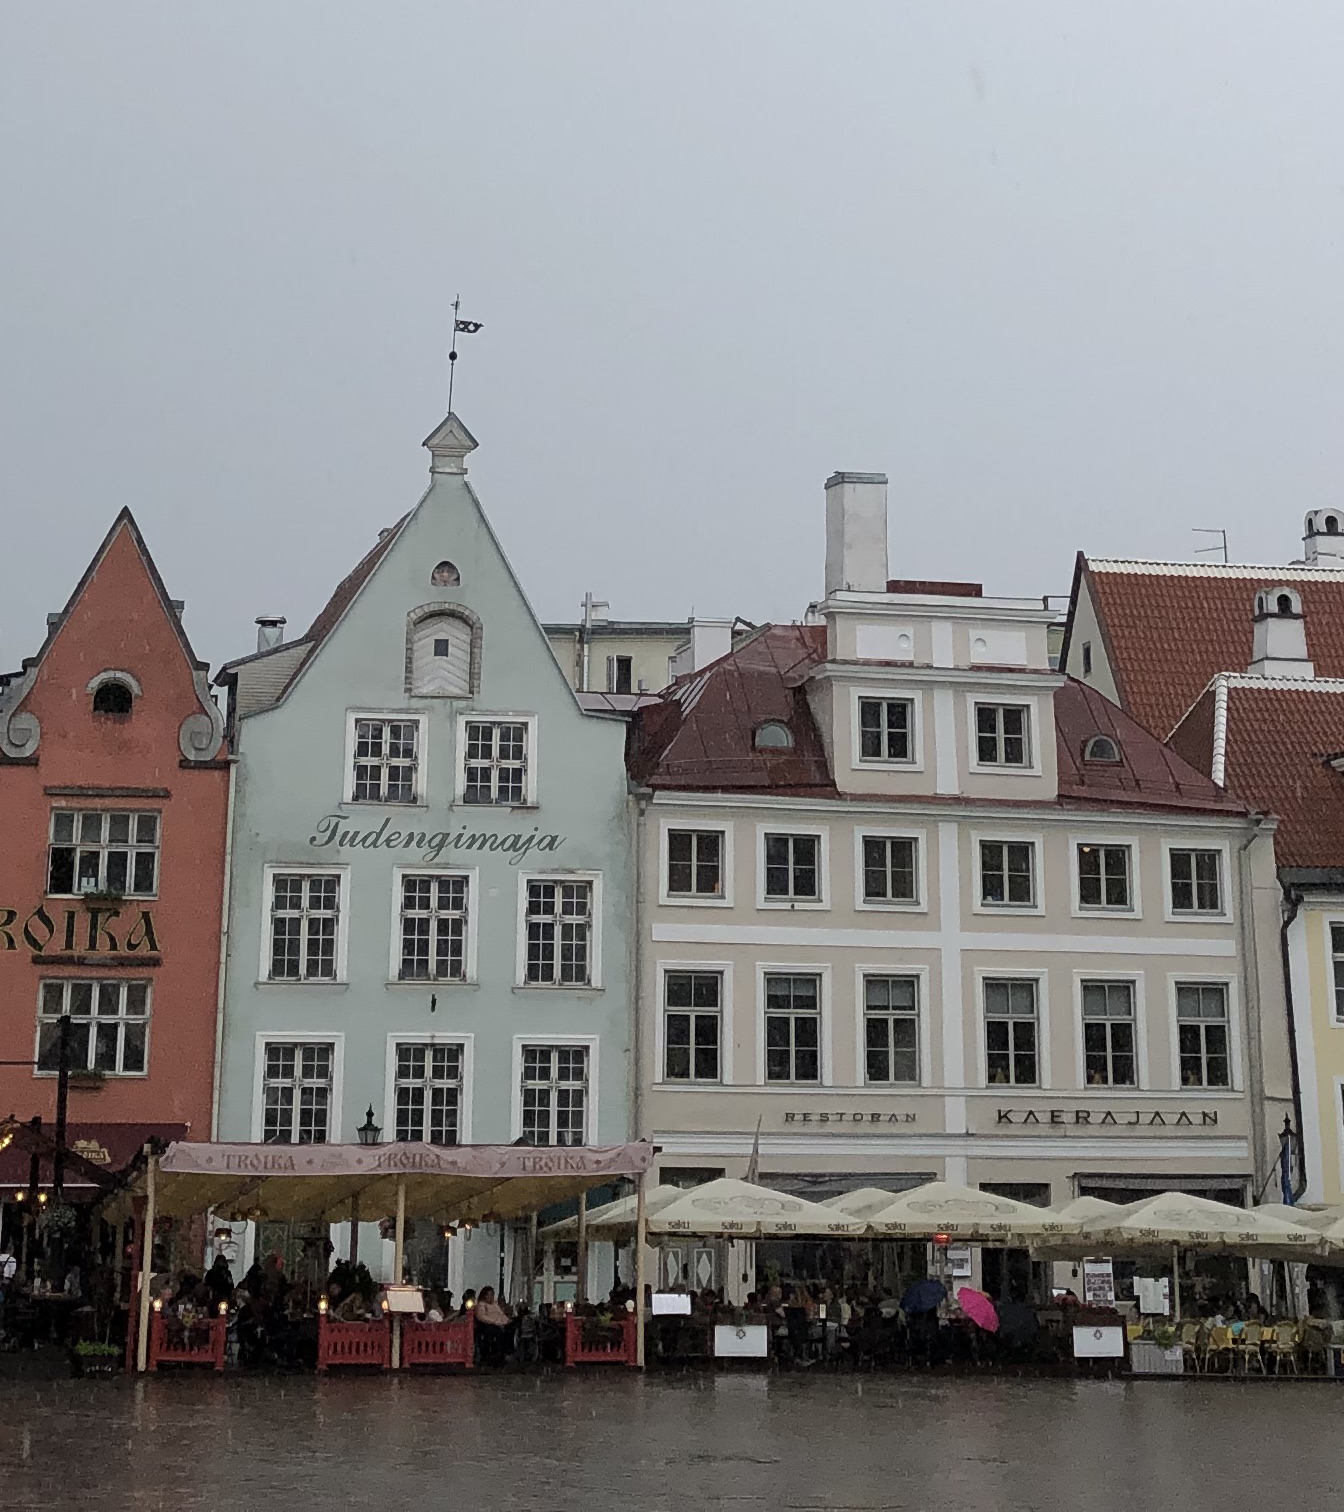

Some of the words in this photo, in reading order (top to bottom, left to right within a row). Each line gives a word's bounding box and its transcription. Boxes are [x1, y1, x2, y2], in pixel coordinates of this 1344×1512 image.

[309, 814, 567, 865] Tudengimaja
[784, 1112, 916, 1122] RESTORAN
[997, 1109, 1218, 1125] KAERAJAAN
[221, 1153, 296, 1170] TROIKA
[374, 1151, 442, 1169] TROIKA
[517, 1155, 586, 1171] TROIKA
[667, 1220, 690, 1230] saku
[721, 1220, 743, 1230] saku
[775, 1221, 797, 1231] saku
[828, 1222, 849, 1232] saku
[885, 1221, 906, 1231] saku
[937, 1221, 958, 1231] saku
[990, 1222, 1011, 1232] saku
